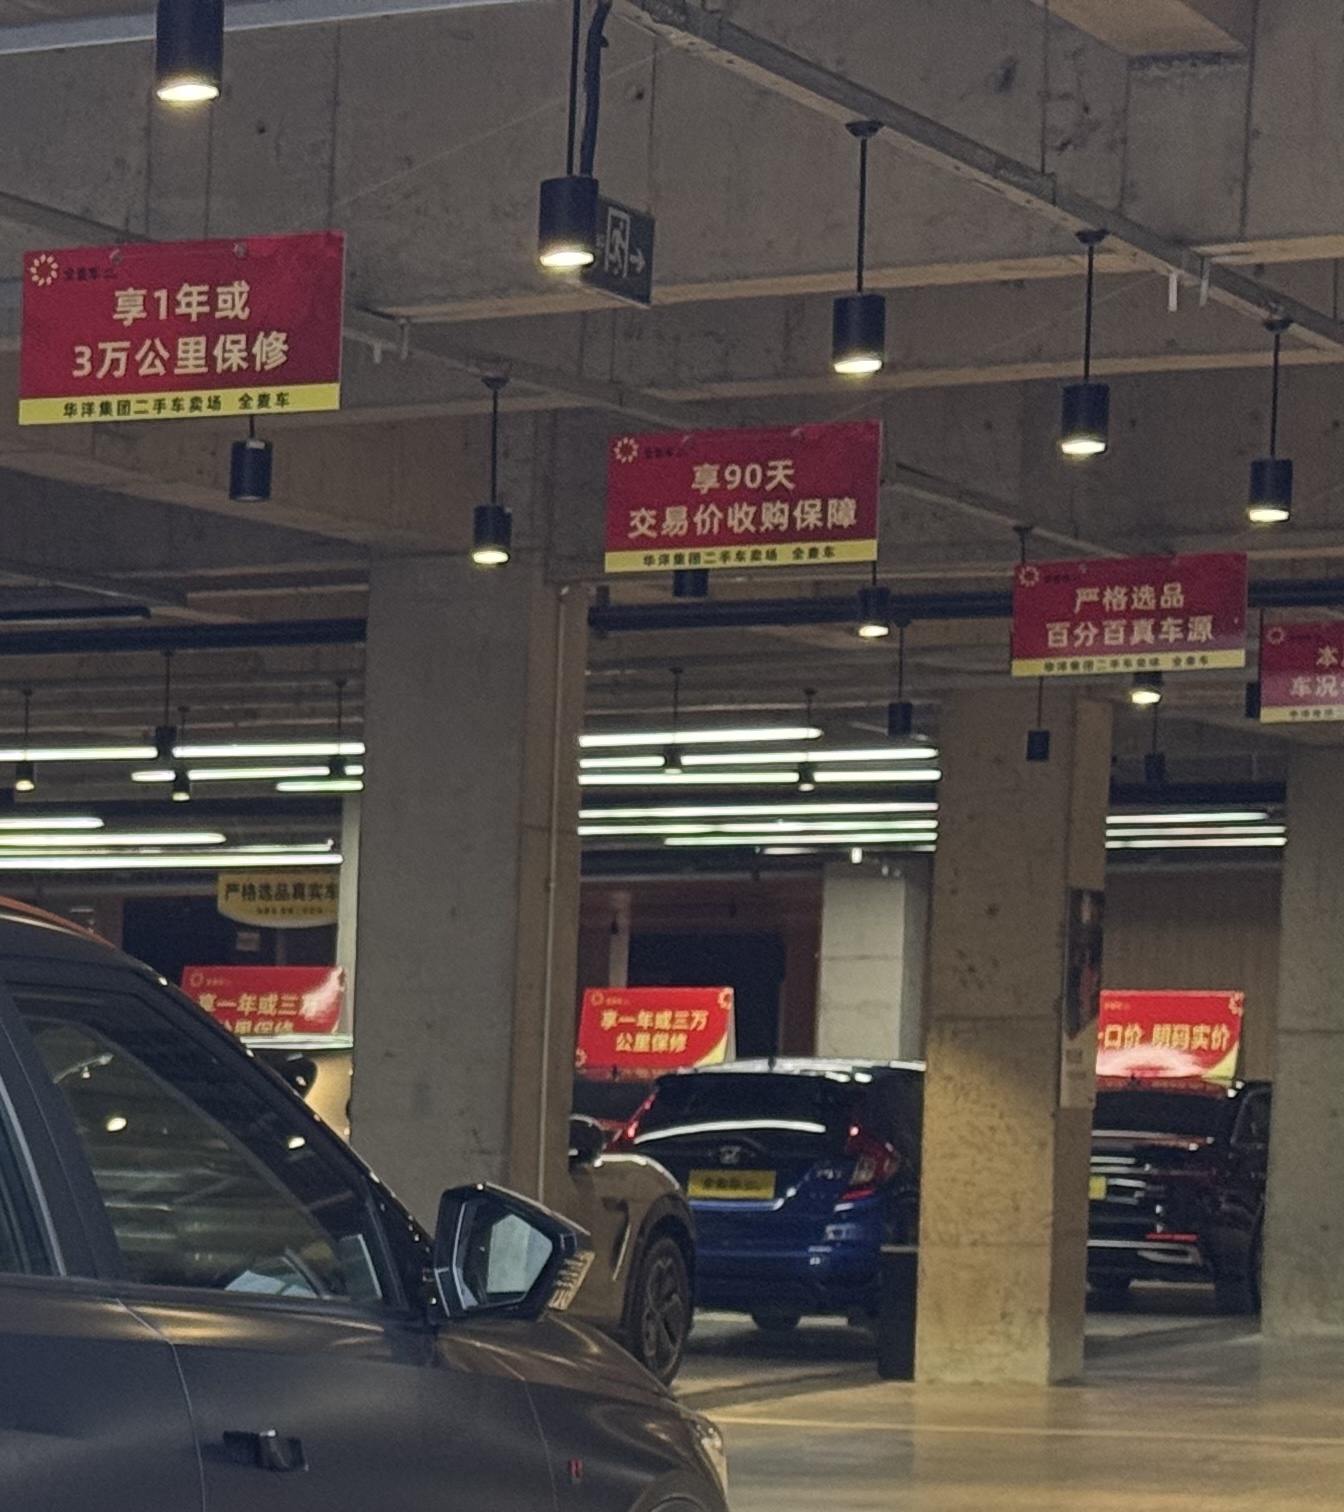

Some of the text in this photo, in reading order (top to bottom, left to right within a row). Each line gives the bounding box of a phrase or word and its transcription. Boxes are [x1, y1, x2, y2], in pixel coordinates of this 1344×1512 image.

[112, 280, 251, 326] 享1年或
[72, 330, 289, 380] 3万公里保修
[63, 394, 223, 418] 华洋集团二手车卖场
[691, 459, 796, 494] 享90天
[627, 497, 858, 539] 交易价收购保障
[1073, 582, 1185, 614] 严格选品
[1045, 614, 1215, 649] 百分百真车源
[1289, 674, 1344, 698] 车况
[600, 1008, 710, 1032] 享一年或三万
[1098, 1022, 1145, 1051] 口价
